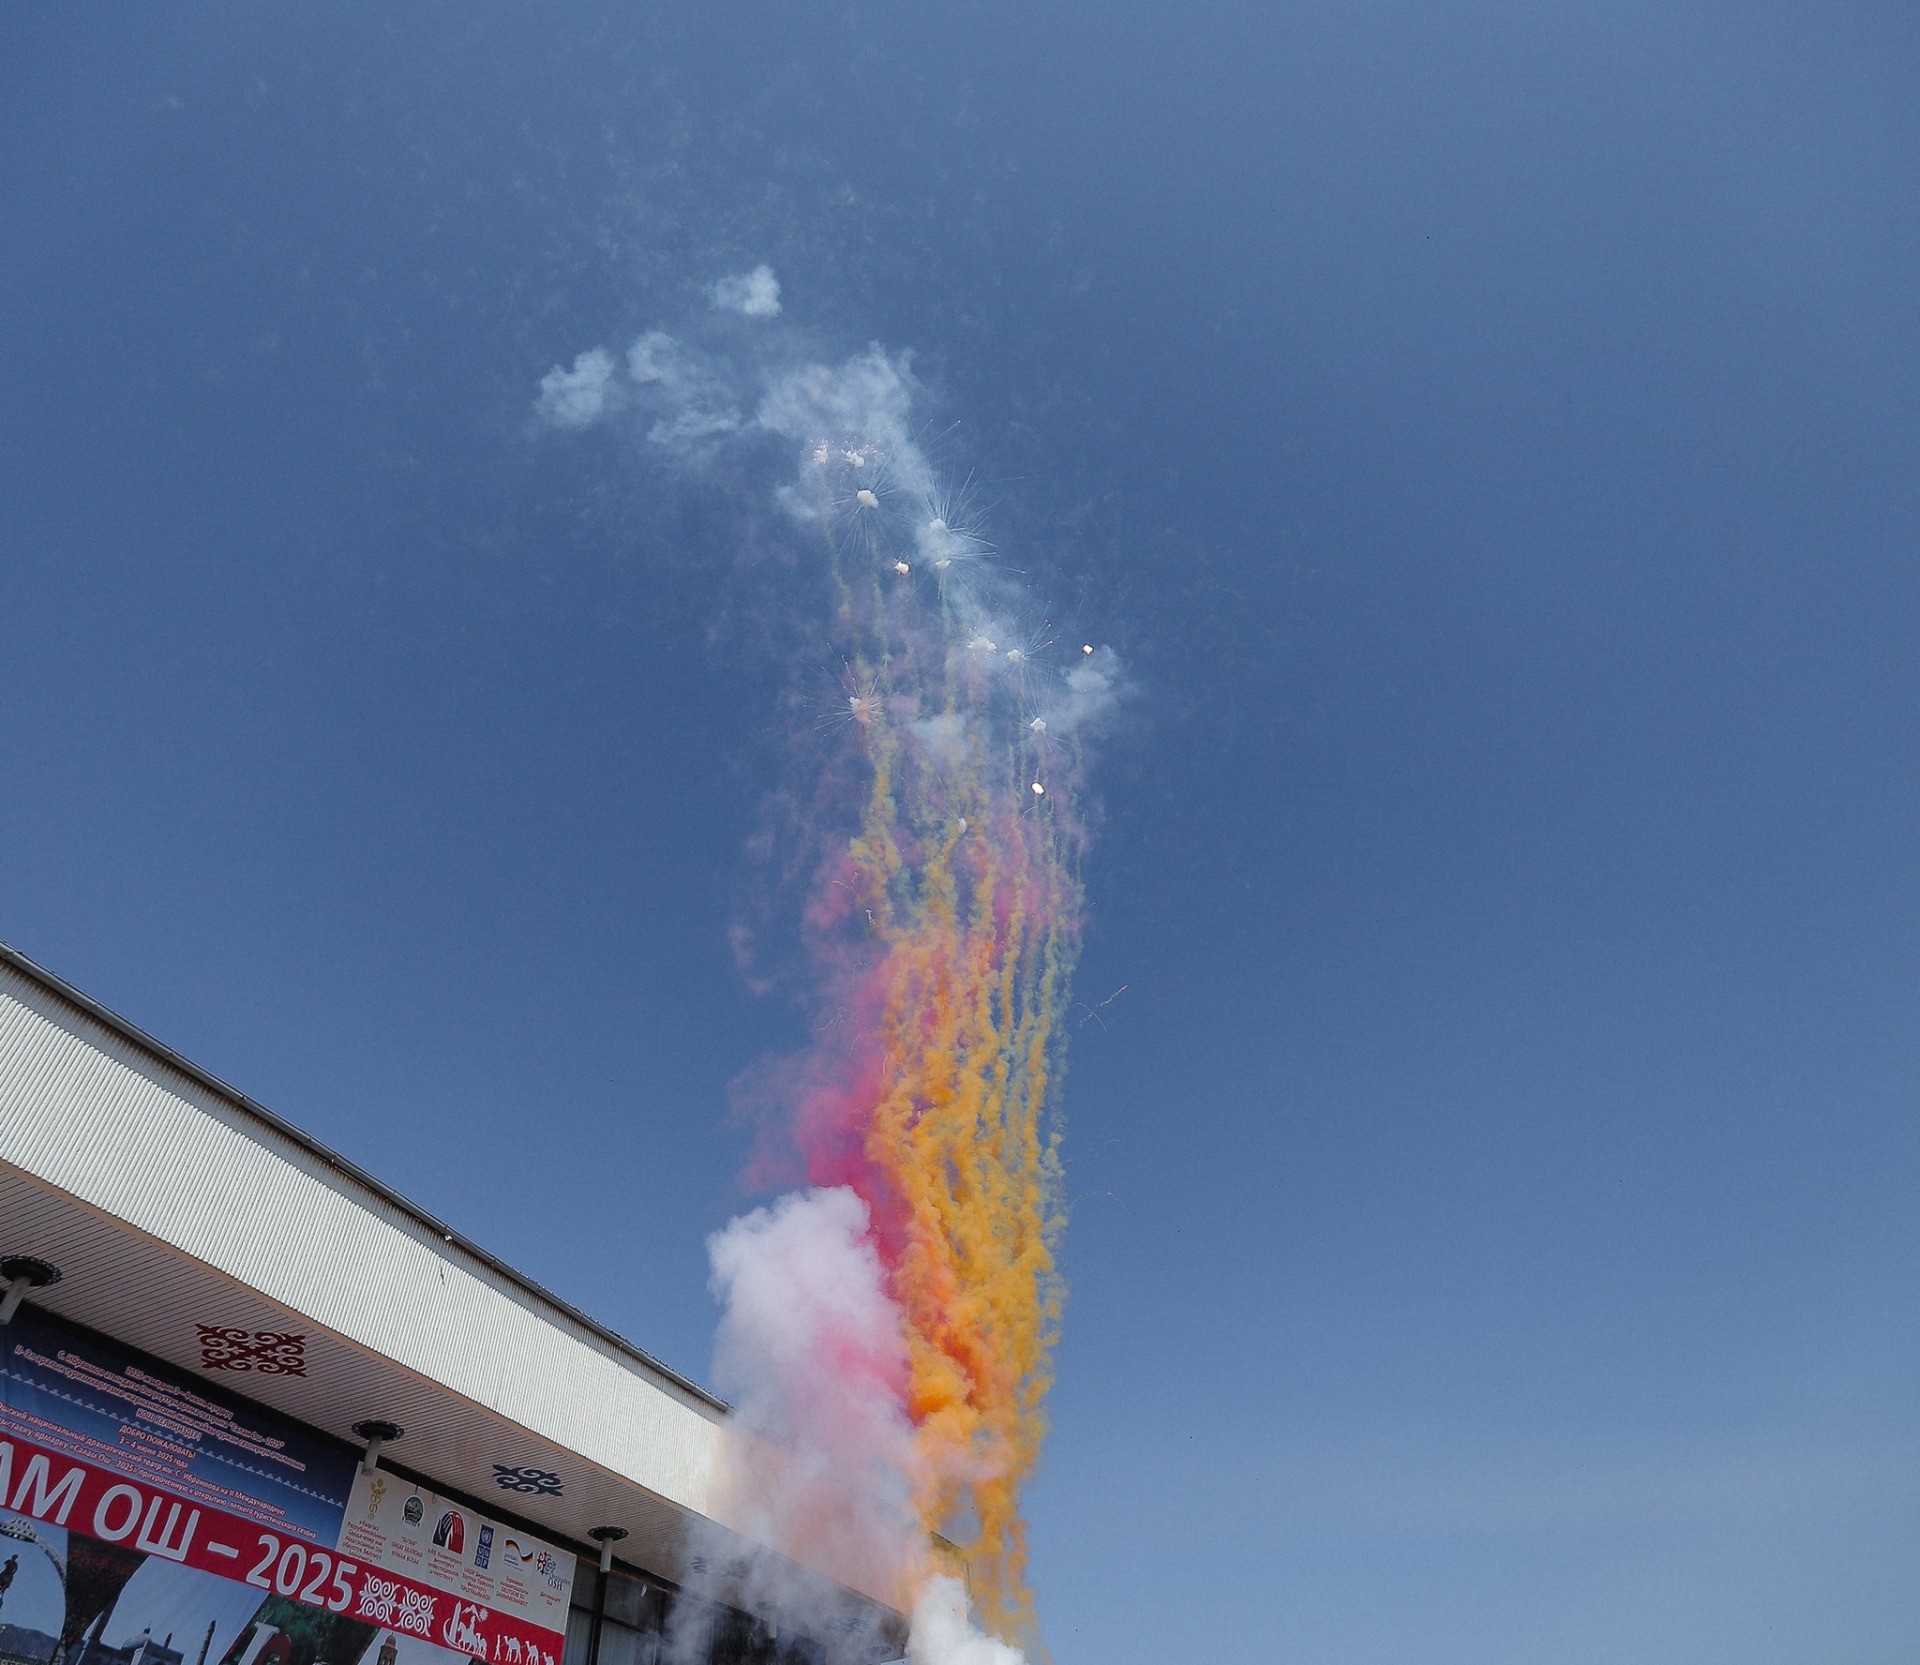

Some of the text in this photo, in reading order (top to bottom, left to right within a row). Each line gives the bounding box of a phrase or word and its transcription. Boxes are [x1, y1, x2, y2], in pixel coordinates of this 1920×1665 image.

[136, 1407, 155, 1421] КОШ
[119, 1424, 196, 1459] ДОБРО ПОЖАЛОВАТЬ!
[130, 1440, 136, 1448] 4
[135, 1444, 156, 1456] июня
[156, 1450, 173, 1462] 2025
[172, 1457, 188, 1468] года
[27, 1413, 86, 1442] национальный
[85, 1435, 142, 1463] драматический
[142, 1458, 161, 1471] театр
[174, 1470, 183, 1478] С.
[182, 1472, 220, 1492] Ибраимова
[234, 1491, 286, 1516] Международную
[68, 1443, 98, 1459] «Салам
[98, 1453, 110, 1463] Ош
[116, 1460, 137, 1473] 2025»
[137, 1468, 189, 1492] приуроченную
[193, 1489, 226, 1506] открытию
[228, 1501, 252, 1515] летнего
[252, 1510, 296, 1532] туристического
[296, 1526, 316, 1538] сезона
[94, 1484, 200, 1562] ОШ
[246, 1534, 358, 1611] 2025
[548, 1578, 562, 1590] OSH
